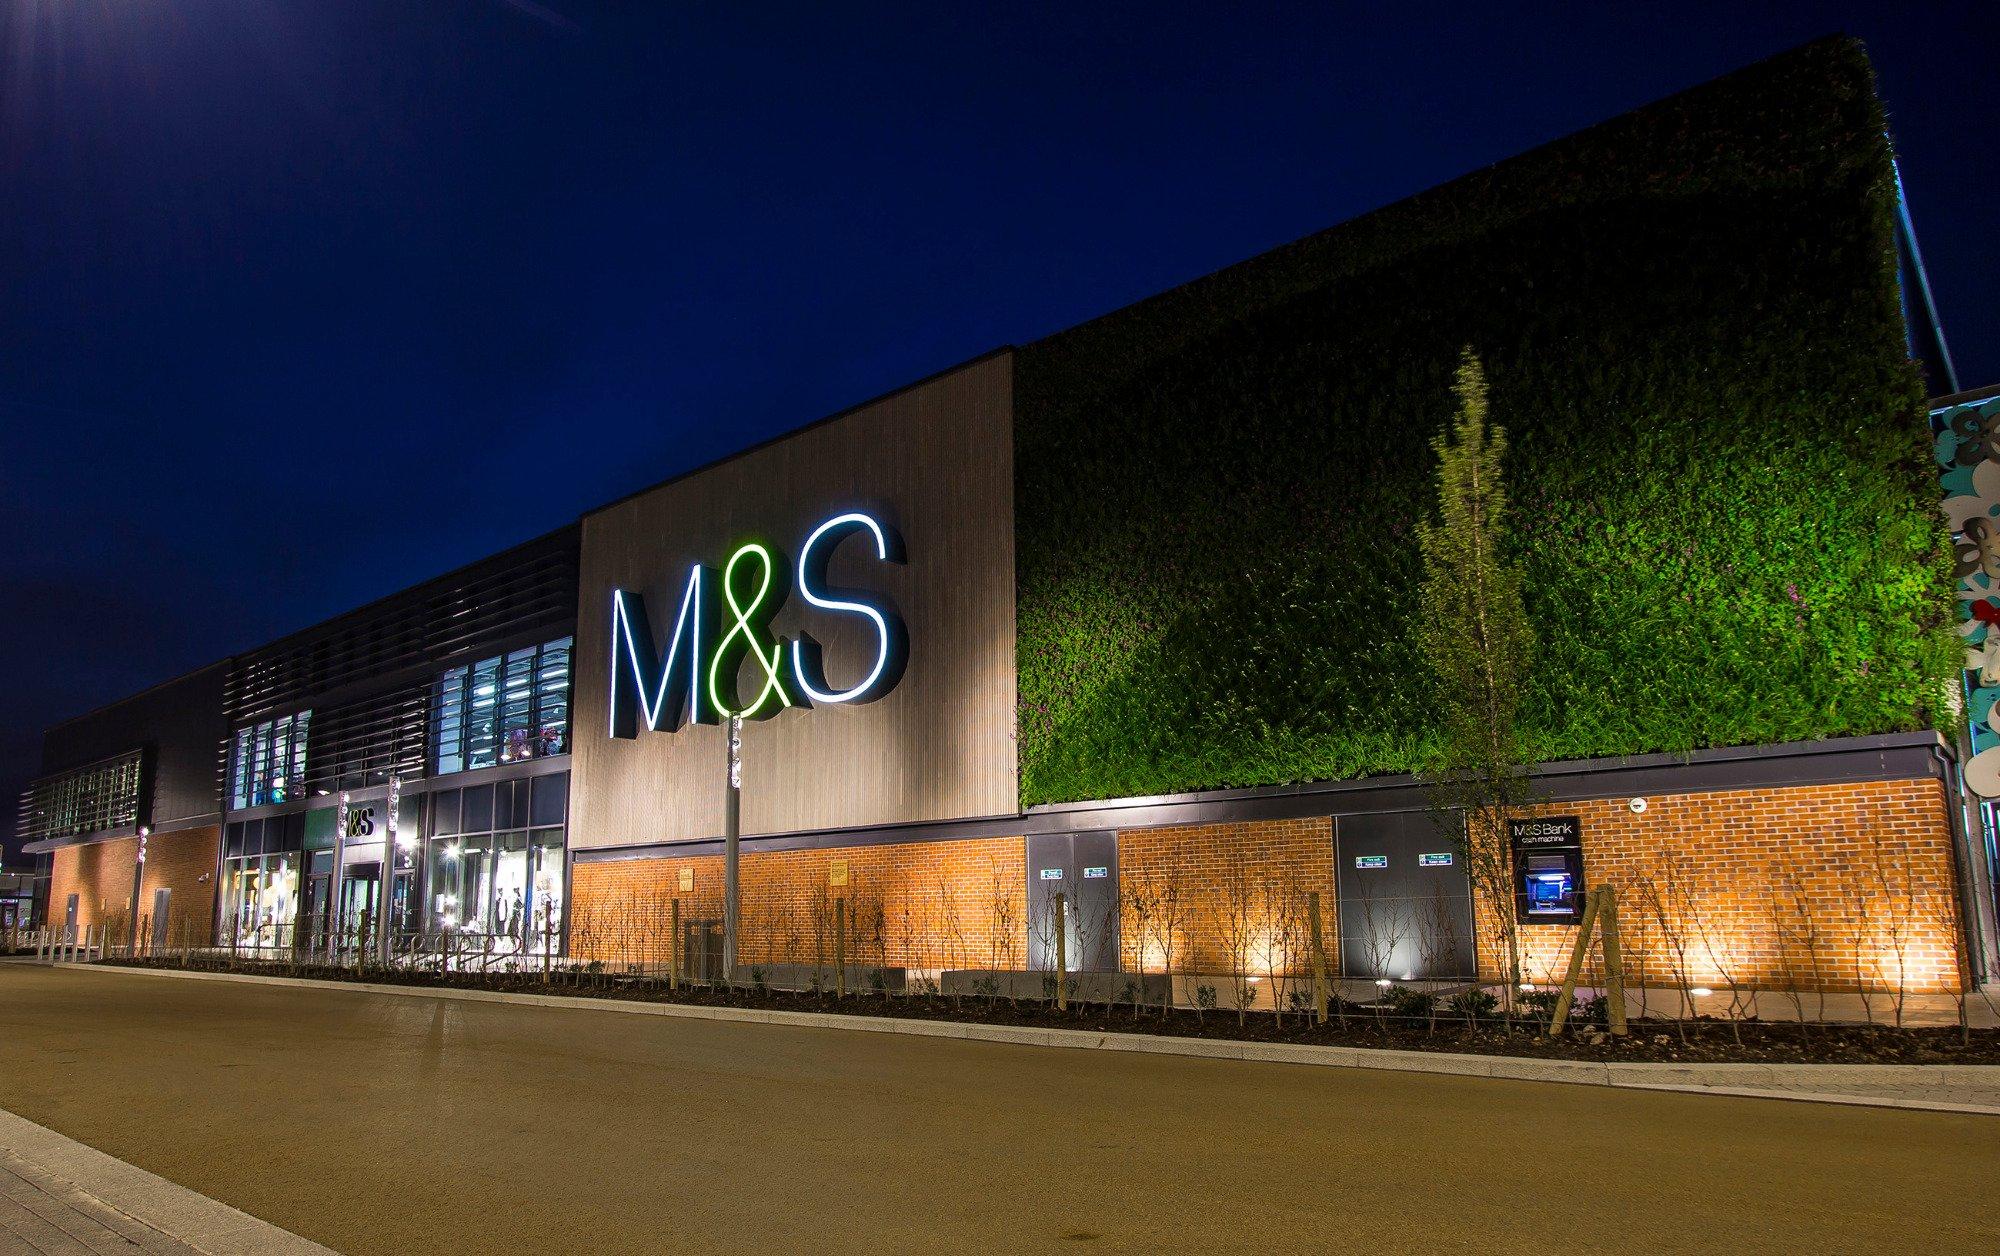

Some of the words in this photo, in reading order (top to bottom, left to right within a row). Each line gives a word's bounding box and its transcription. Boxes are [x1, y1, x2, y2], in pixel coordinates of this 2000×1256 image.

[609, 512, 890, 740] M&S
[1514, 823, 1541, 836] M&S
[1542, 822, 1572, 835] Bank
[1537, 835, 1565, 843] machine
